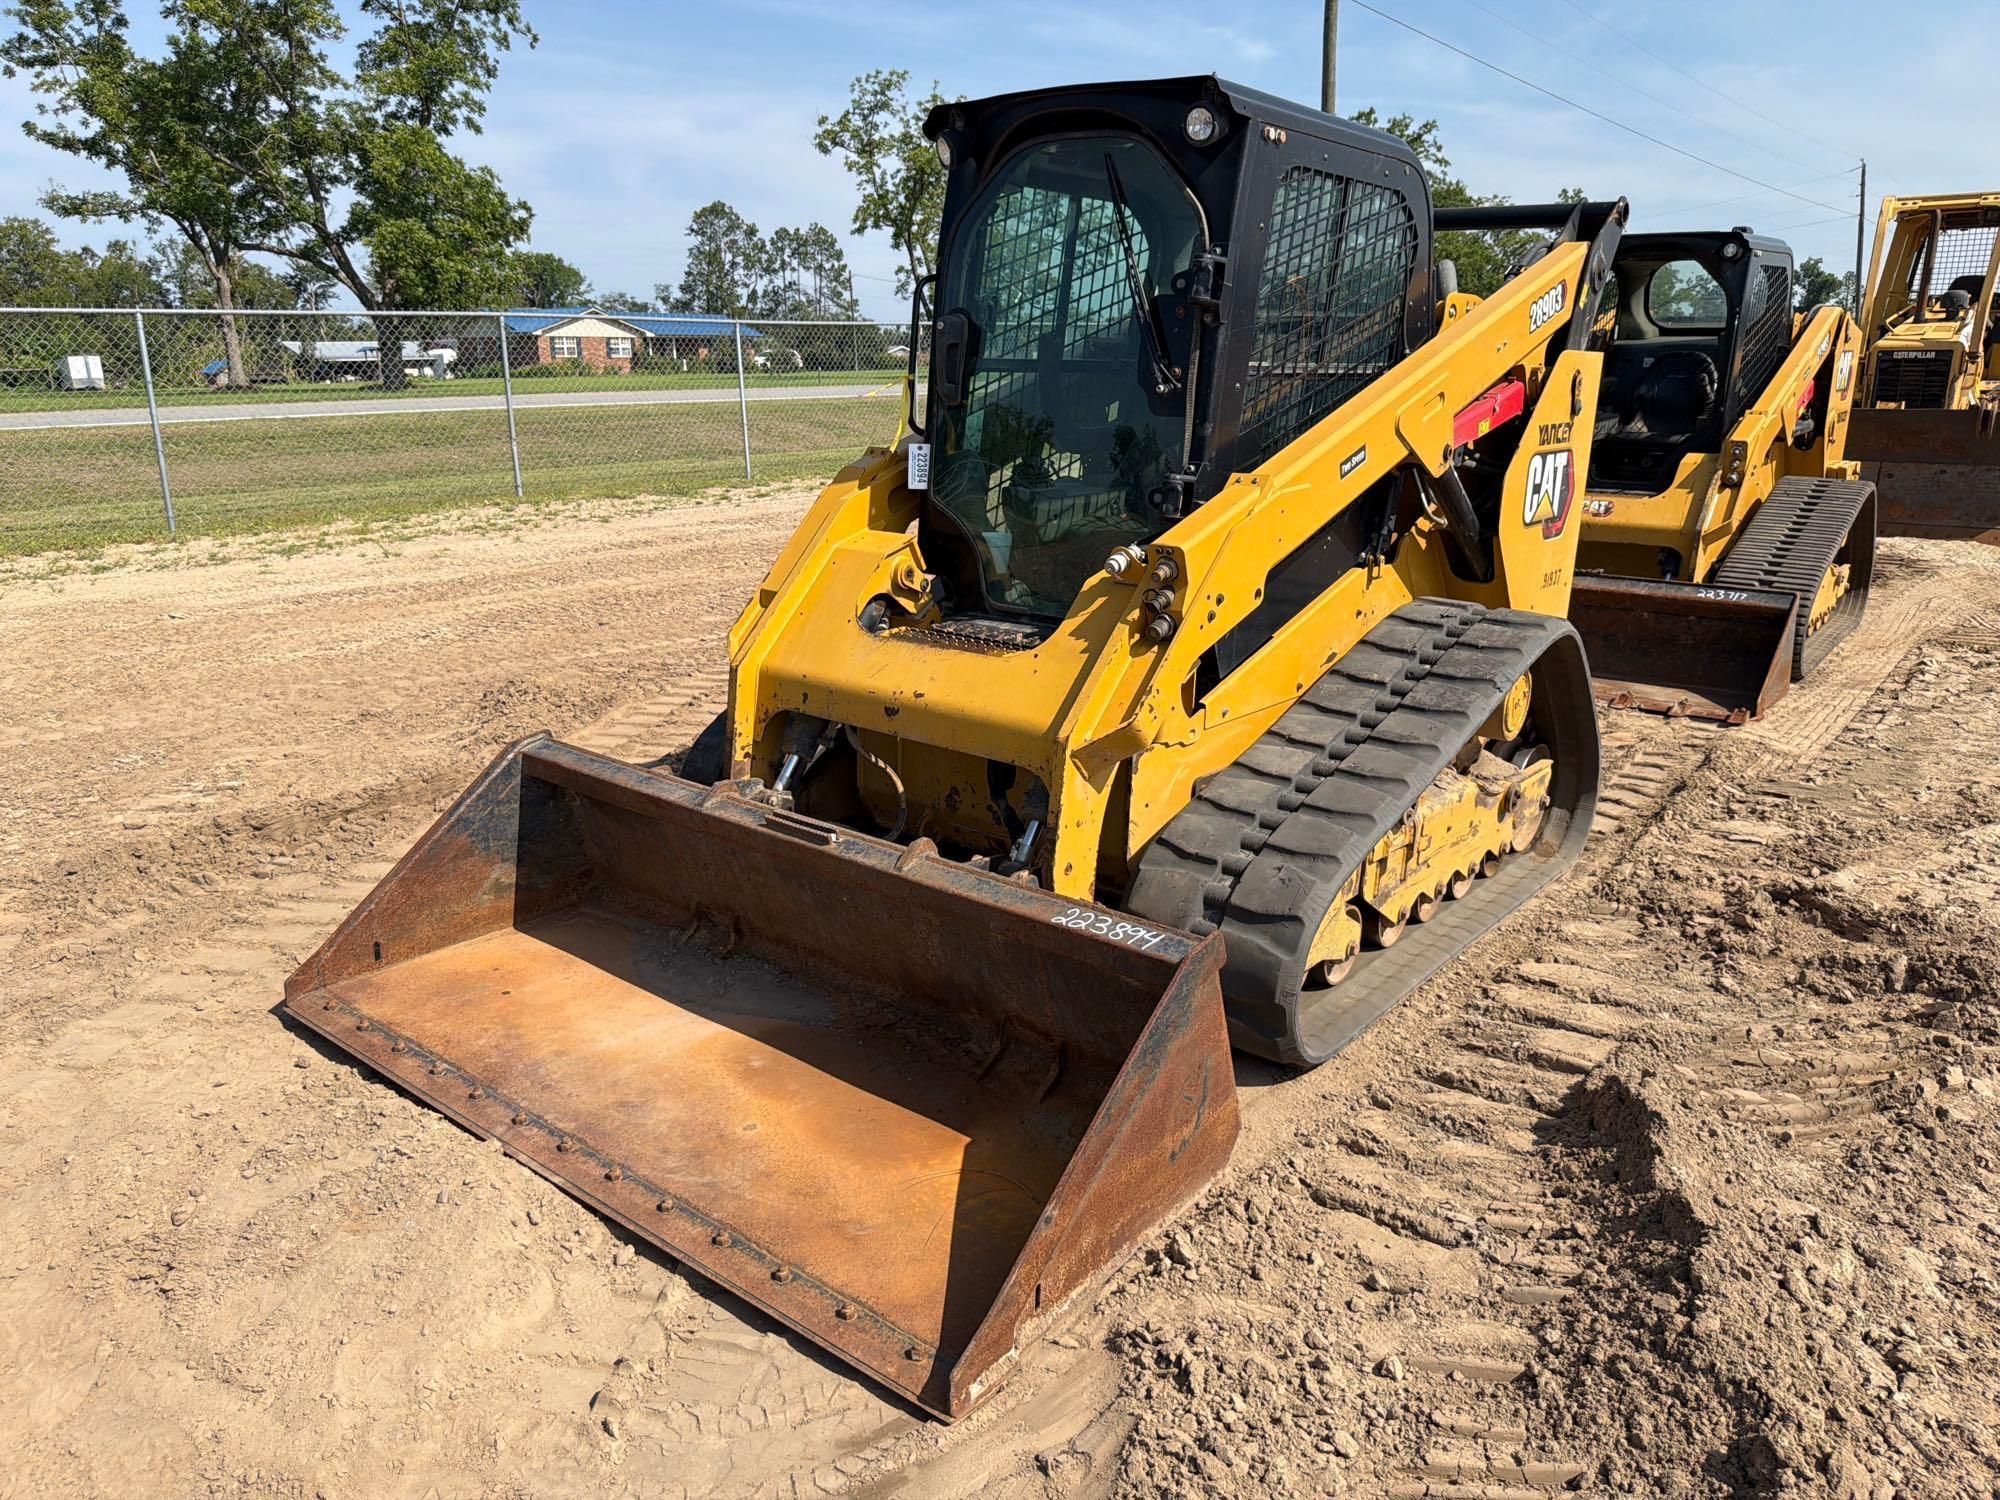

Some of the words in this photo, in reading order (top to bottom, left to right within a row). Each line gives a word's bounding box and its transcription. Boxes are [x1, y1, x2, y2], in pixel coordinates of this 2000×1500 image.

[1529, 281, 1563, 334] 289D3
[1836, 350, 1853, 391] CAT
[1893, 351, 1936, 359] CATERPILLAR
[1538, 421, 1574, 446] YANCEY
[916, 452, 928, 483] 223894
[1523, 451, 1569, 524] CAT
[1582, 499, 1611, 514] CAT
[1050, 908, 1166, 950] 223894
